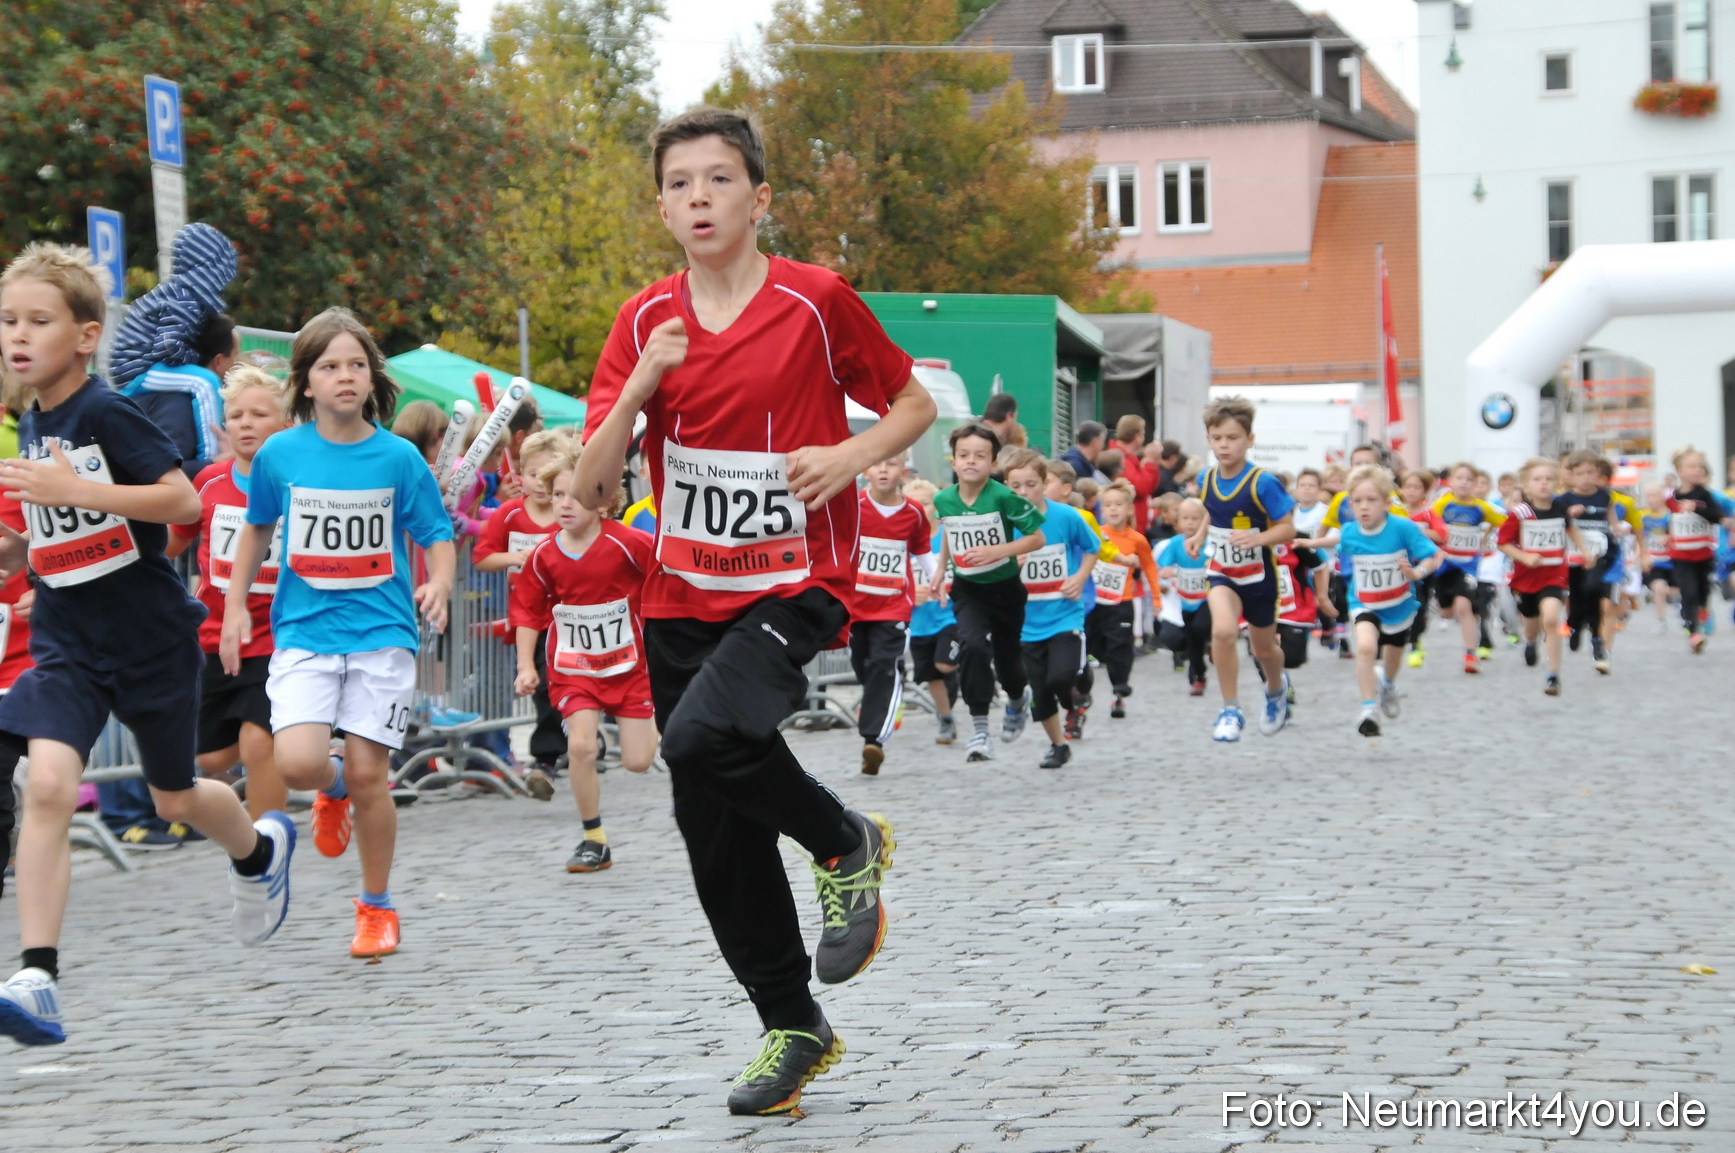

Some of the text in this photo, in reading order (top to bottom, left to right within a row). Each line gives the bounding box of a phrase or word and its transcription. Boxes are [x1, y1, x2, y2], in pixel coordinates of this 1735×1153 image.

[153, 89, 175, 151] P
[484, 404, 512, 438] BMW
[667, 455, 780, 480] PARTL Neumarkt
[293, 498, 378, 510] PARTL Neumarkt
[675, 480, 793, 539] 7025
[215, 512, 243, 524] PARTL
[300, 513, 384, 551] 7600
[950, 527, 1000, 551] 7088
[40, 541, 107, 571] Johannes
[691, 547, 770, 572] Valentin
[858, 550, 902, 574] 7092
[1027, 558, 1062, 580] 036
[563, 617, 623, 650] 7017
[384, 702, 410, 734] 10
